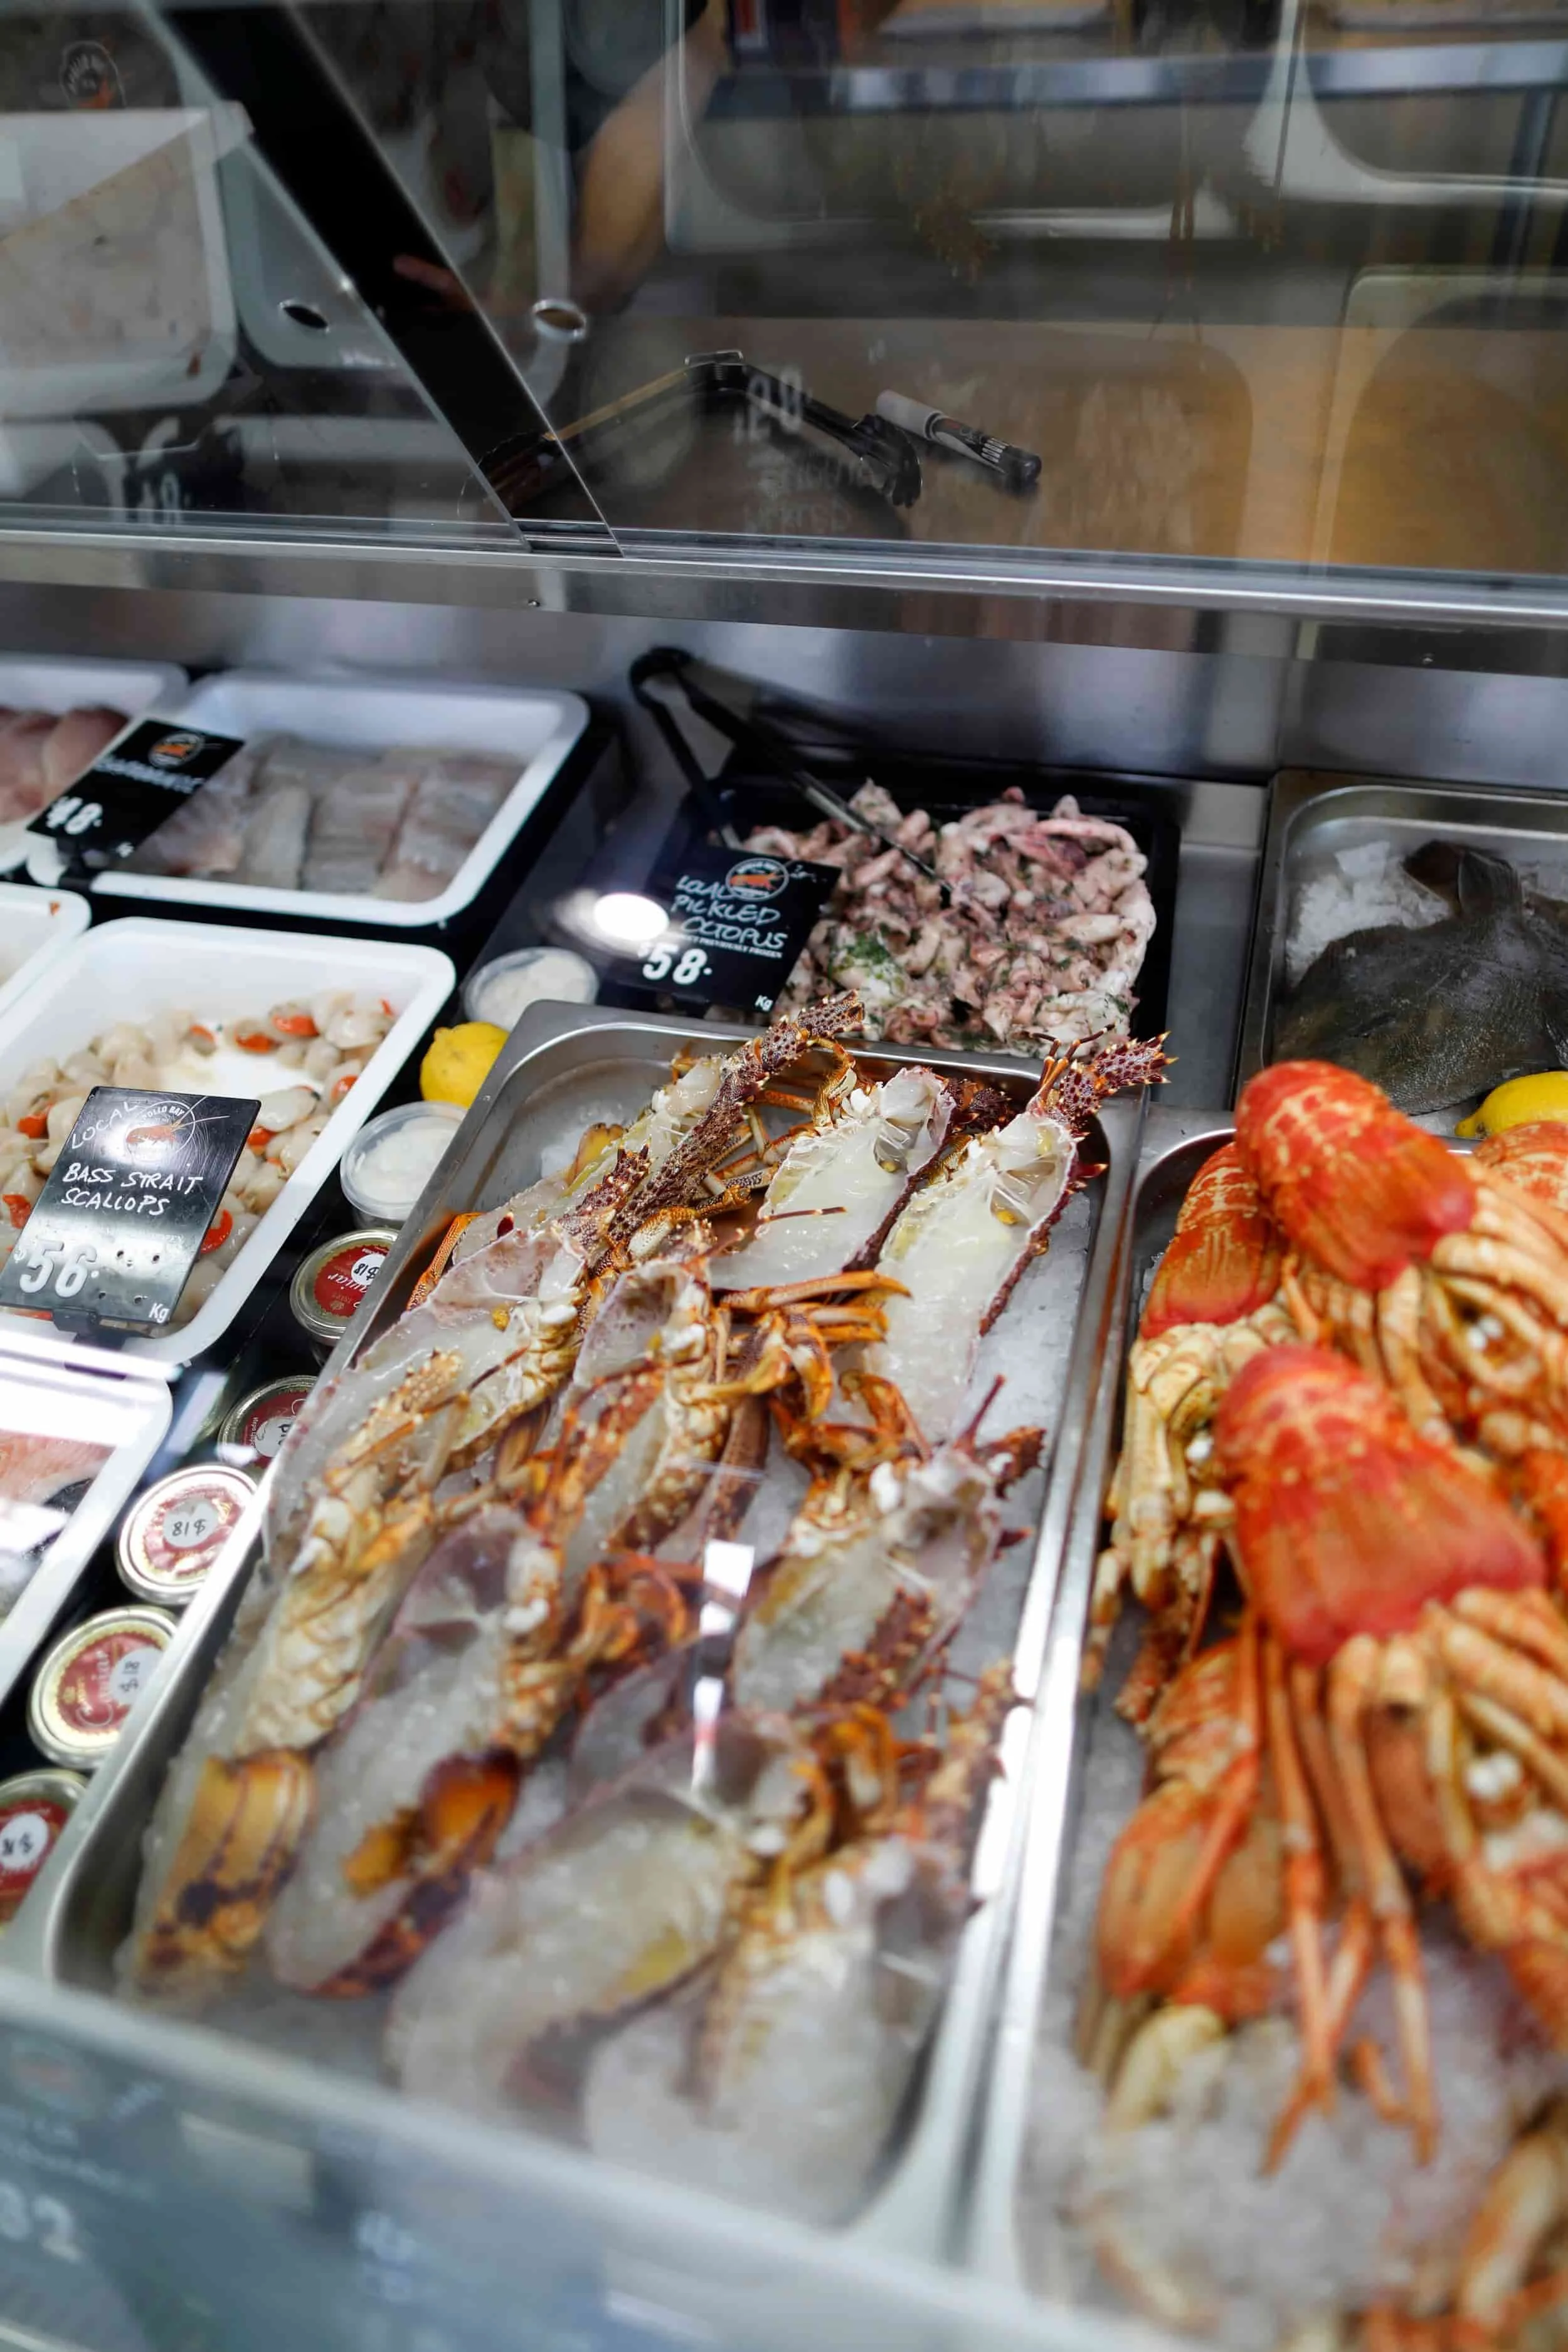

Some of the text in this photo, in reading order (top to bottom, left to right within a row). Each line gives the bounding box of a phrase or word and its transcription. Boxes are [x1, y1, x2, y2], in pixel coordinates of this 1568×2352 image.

[670, 894, 781, 926] PICKLED
[681, 916, 788, 949] OCTOPUS
[755, 995, 773, 1011] Kg
[72, 1101, 139, 1150] LOCAL
[63, 1162, 204, 1195] BASS STRAIT
[61, 1187, 170, 1216] SCALLOPS
[148, 1303, 171, 1324] Kg
